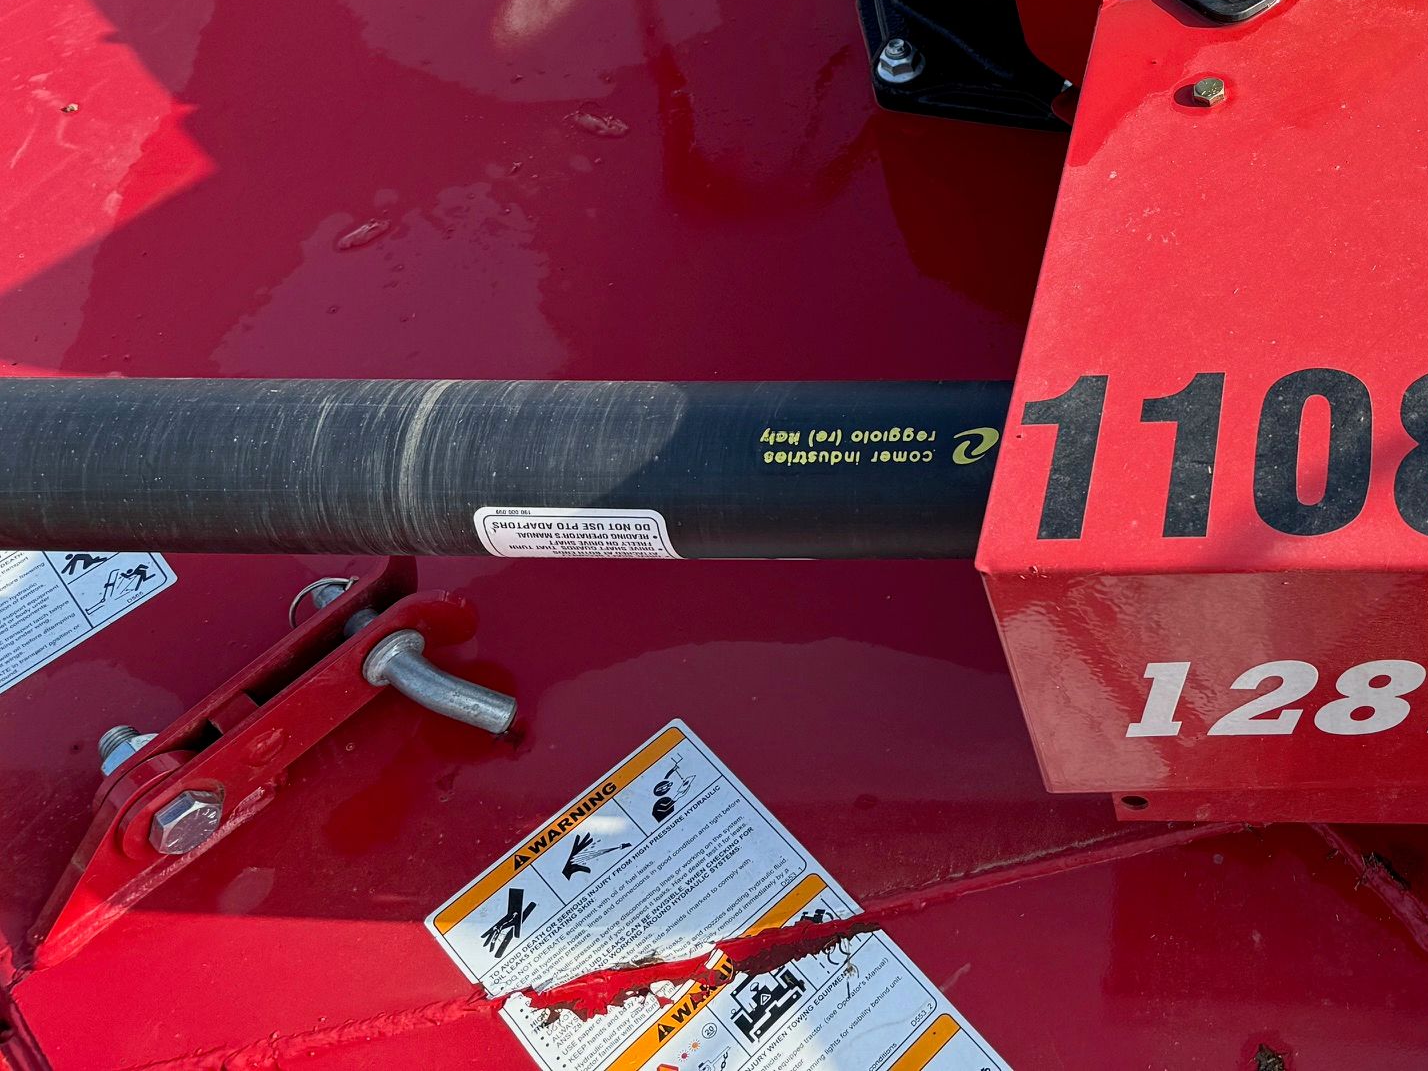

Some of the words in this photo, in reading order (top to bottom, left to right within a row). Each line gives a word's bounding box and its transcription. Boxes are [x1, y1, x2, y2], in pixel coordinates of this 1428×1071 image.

[809, 429, 842, 447] (re)
[851, 428, 936, 445] reggiolo
[763, 451, 860, 466] industries
[871, 451, 933, 464] comer
[492, 521, 552, 530] ADAPTORS
[557, 522, 576, 530] PTO
[582, 523, 603, 531] USE
[609, 523, 627, 531] NOT
[630, 523, 650, 531] DO
[527, 779, 617, 856] WARNING
[704, 838, 740, 868] CHECKING
[738, 826, 754, 840] FOR
[489, 969, 500, 980] TO
[499, 951, 522, 971] AVOID
[521, 931, 546, 953] DEATH
[545, 921, 557, 932] OR
[556, 896, 588, 923] SERIOUS
[586, 874, 612, 897] INJURY
[611, 858, 632, 876] FROM
[631, 844, 650, 860] HIGH
[648, 814, 684, 845] PRESSURE
[683, 784, 721, 816] HYDRAULIC
[492, 972, 506, 985] OIL
[506, 952, 530, 974] LEAKS
[529, 912, 577, 954] PENETRATING
[577, 896, 596, 914] SKIN:
[766, 1030, 788, 1052] WHEN
